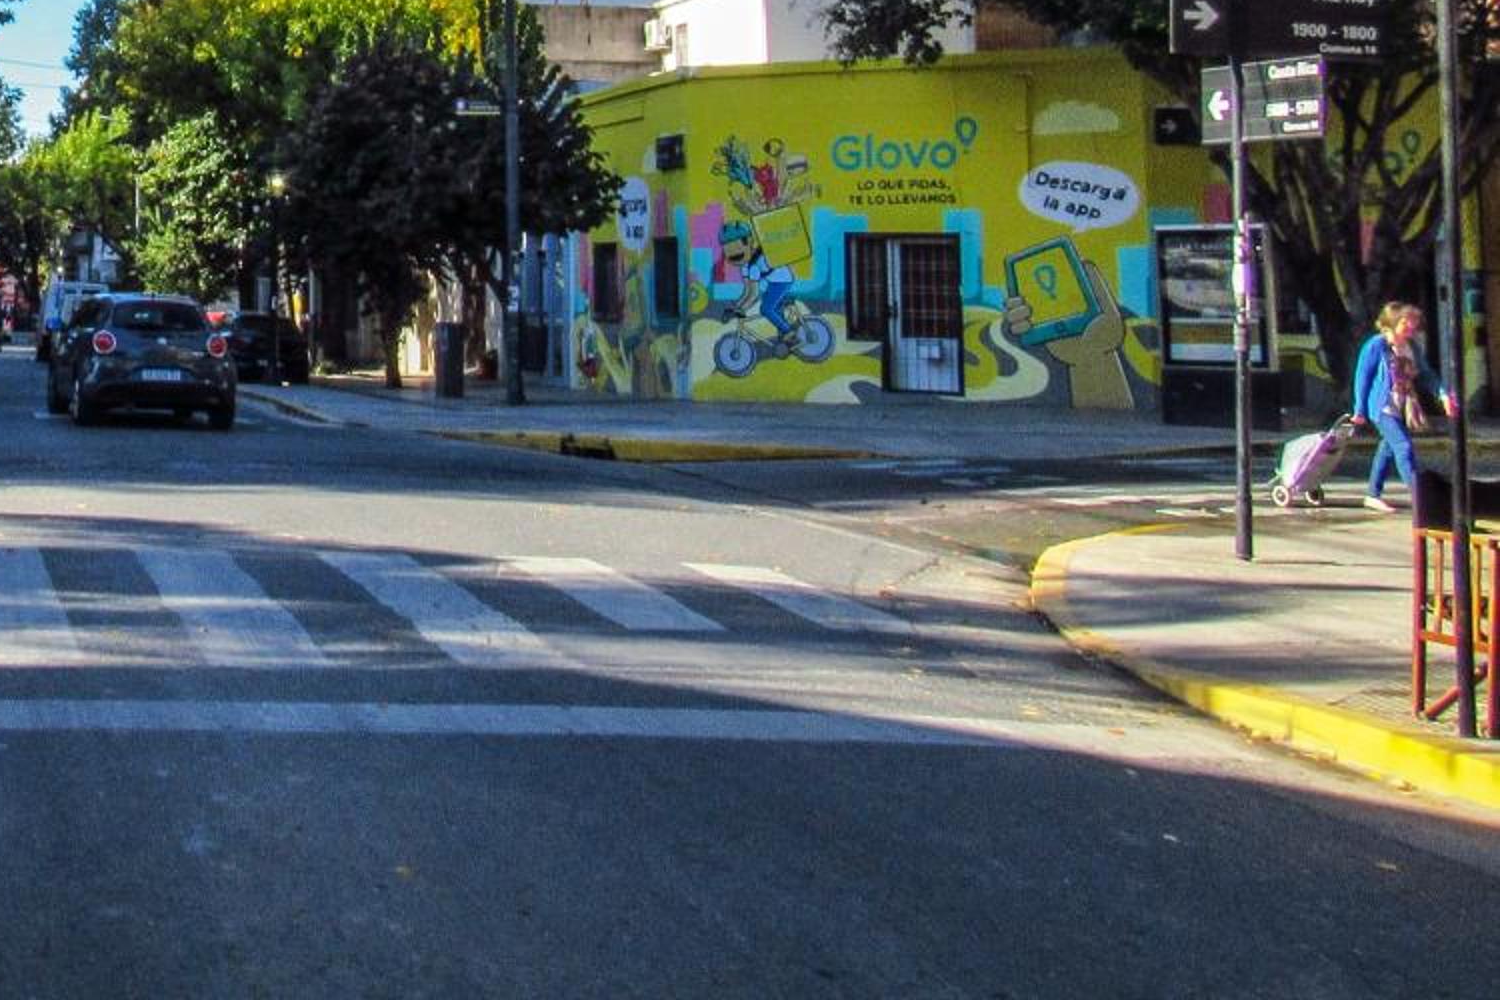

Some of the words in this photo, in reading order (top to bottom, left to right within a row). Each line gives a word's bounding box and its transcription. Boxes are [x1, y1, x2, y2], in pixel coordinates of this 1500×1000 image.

[1291, 23, 1328, 38] 1900
[1341, 24, 1378, 41] 1800
[831, 133, 958, 172] Glovo
[857, 179, 875, 191] LO
[878, 179, 904, 190] QUE
[849, 195, 863, 205] TE
[867, 195, 885, 205] LO
[887, 194, 957, 205] LLEVAMOS
[1043, 195, 1059, 211] la
[1065, 202, 1101, 219] app
